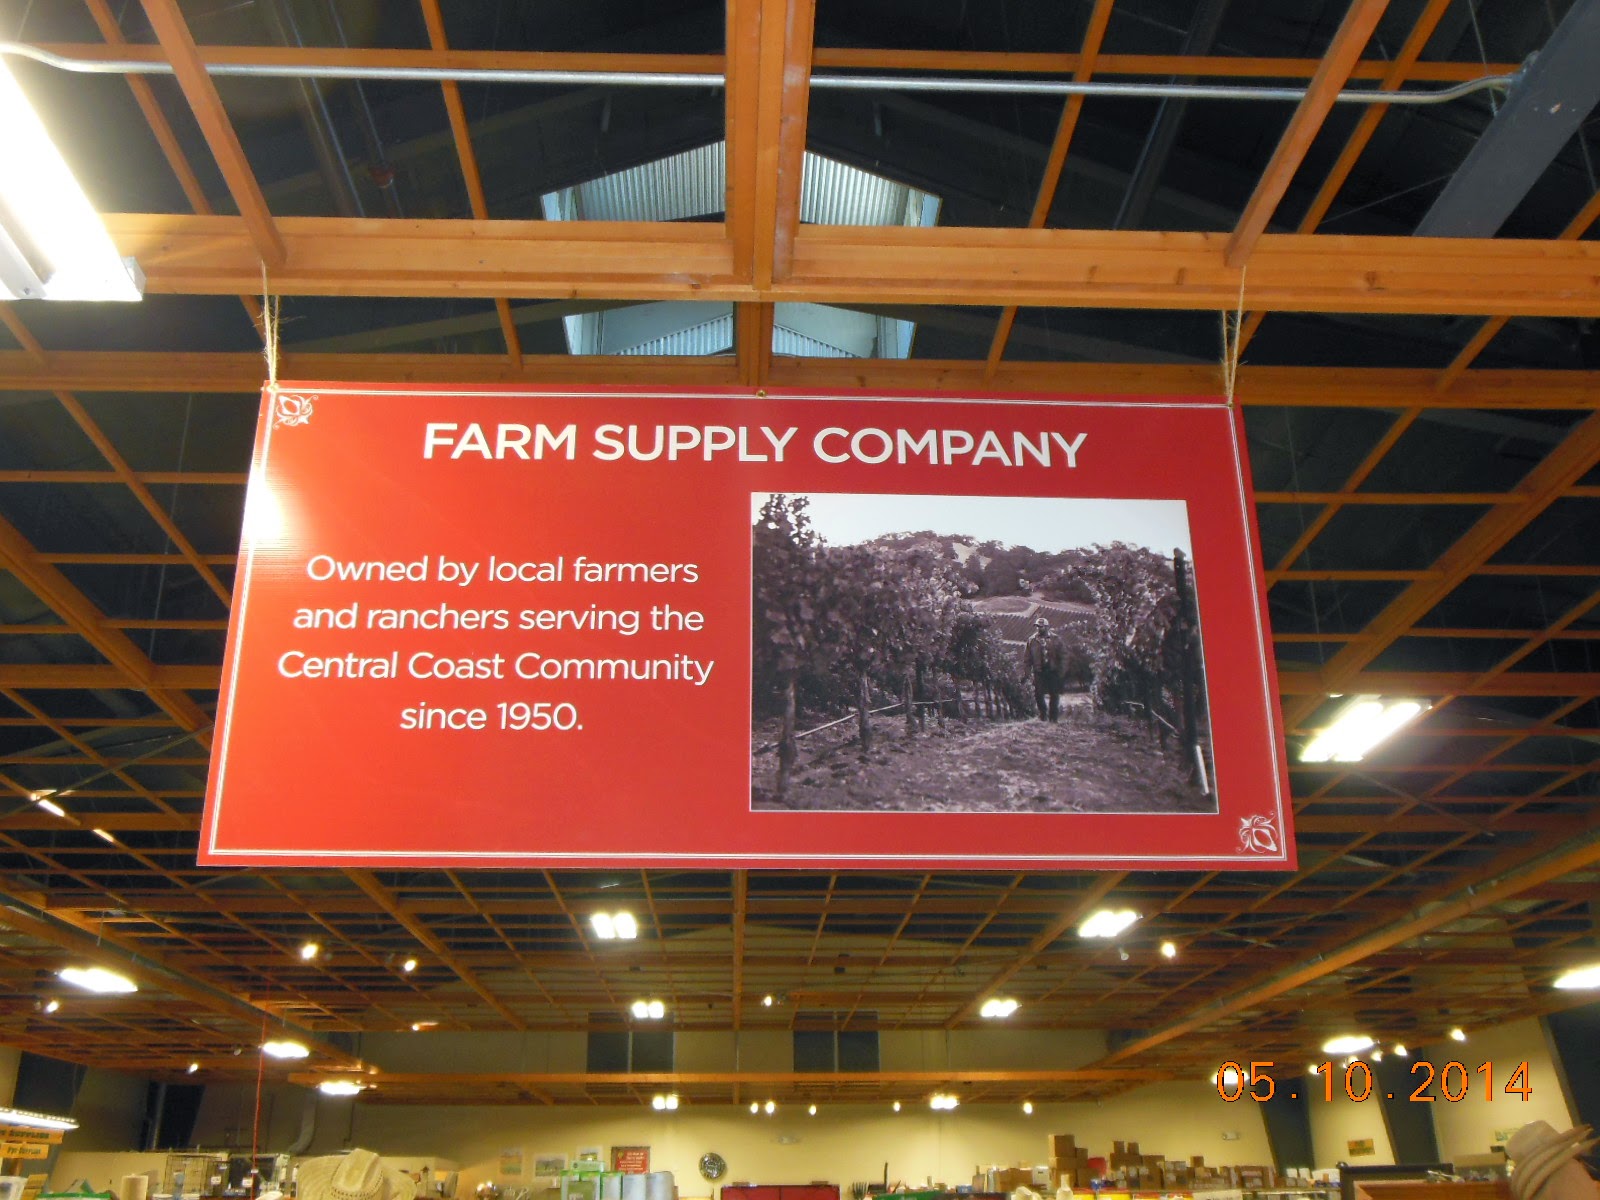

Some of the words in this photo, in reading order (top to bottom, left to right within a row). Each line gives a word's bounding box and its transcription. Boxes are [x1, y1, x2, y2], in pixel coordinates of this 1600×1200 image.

[423, 422, 577, 461] FARM
[593, 424, 799, 463] SUPPLY
[814, 428, 1088, 468] COMPANY
[307, 554, 429, 583] Owned
[437, 555, 481, 587] by
[489, 556, 564, 583] local
[574, 556, 700, 584] farmers
[293, 602, 359, 630] and
[367, 603, 509, 631] ranchers
[519, 604, 641, 636] serving
[650, 605, 706, 632] the
[278, 651, 399, 680] Central
[409, 652, 506, 681] Coast
[515, 653, 715, 686] Community
[400, 702, 488, 731] since
[497, 702, 584, 732] 1950.
